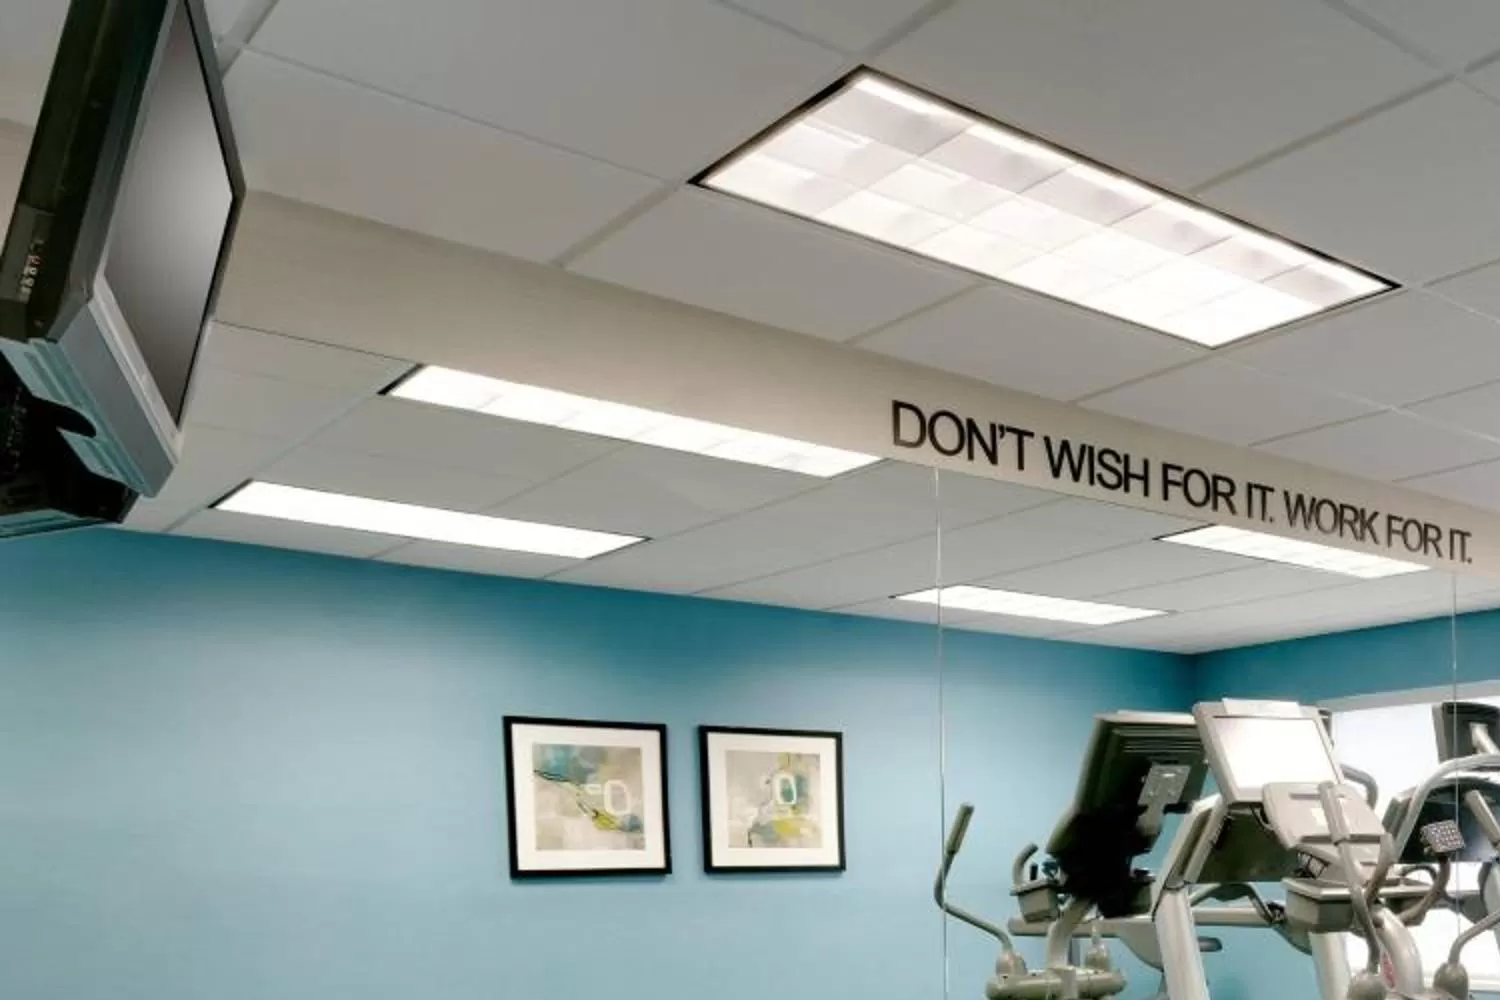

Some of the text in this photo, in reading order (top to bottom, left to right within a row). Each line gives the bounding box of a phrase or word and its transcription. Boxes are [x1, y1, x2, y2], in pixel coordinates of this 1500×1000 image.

[1043, 435, 1149, 497] WISH
[1161, 463, 1236, 516] FOR
[1247, 483, 1275, 523] IT.
[1283, 490, 1380, 545] WORK
[1387, 515, 1443, 558] FOR
[1448, 529, 1473, 564] IT.
